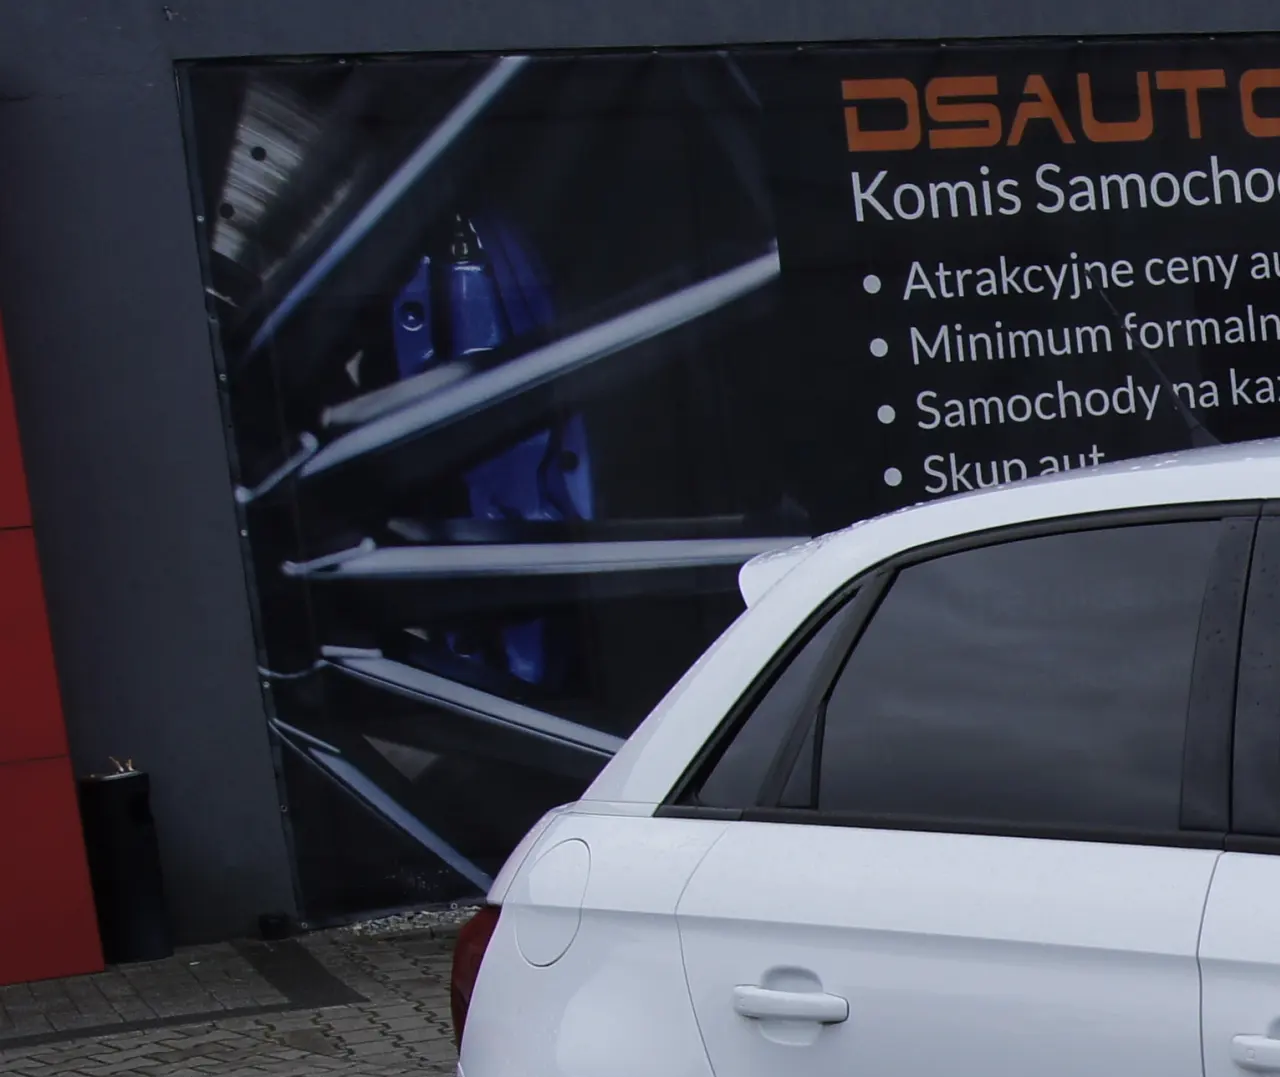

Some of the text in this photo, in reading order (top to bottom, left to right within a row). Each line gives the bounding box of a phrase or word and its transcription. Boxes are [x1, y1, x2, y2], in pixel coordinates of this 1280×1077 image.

[850, 165, 1022, 222] Komis
[902, 252, 1135, 301] Atrakcyjne
[1144, 253, 1239, 290] ceny
[909, 320, 1113, 365] Minimum
[916, 374, 1161, 431] Samochody
[1172, 379, 1220, 409] na
